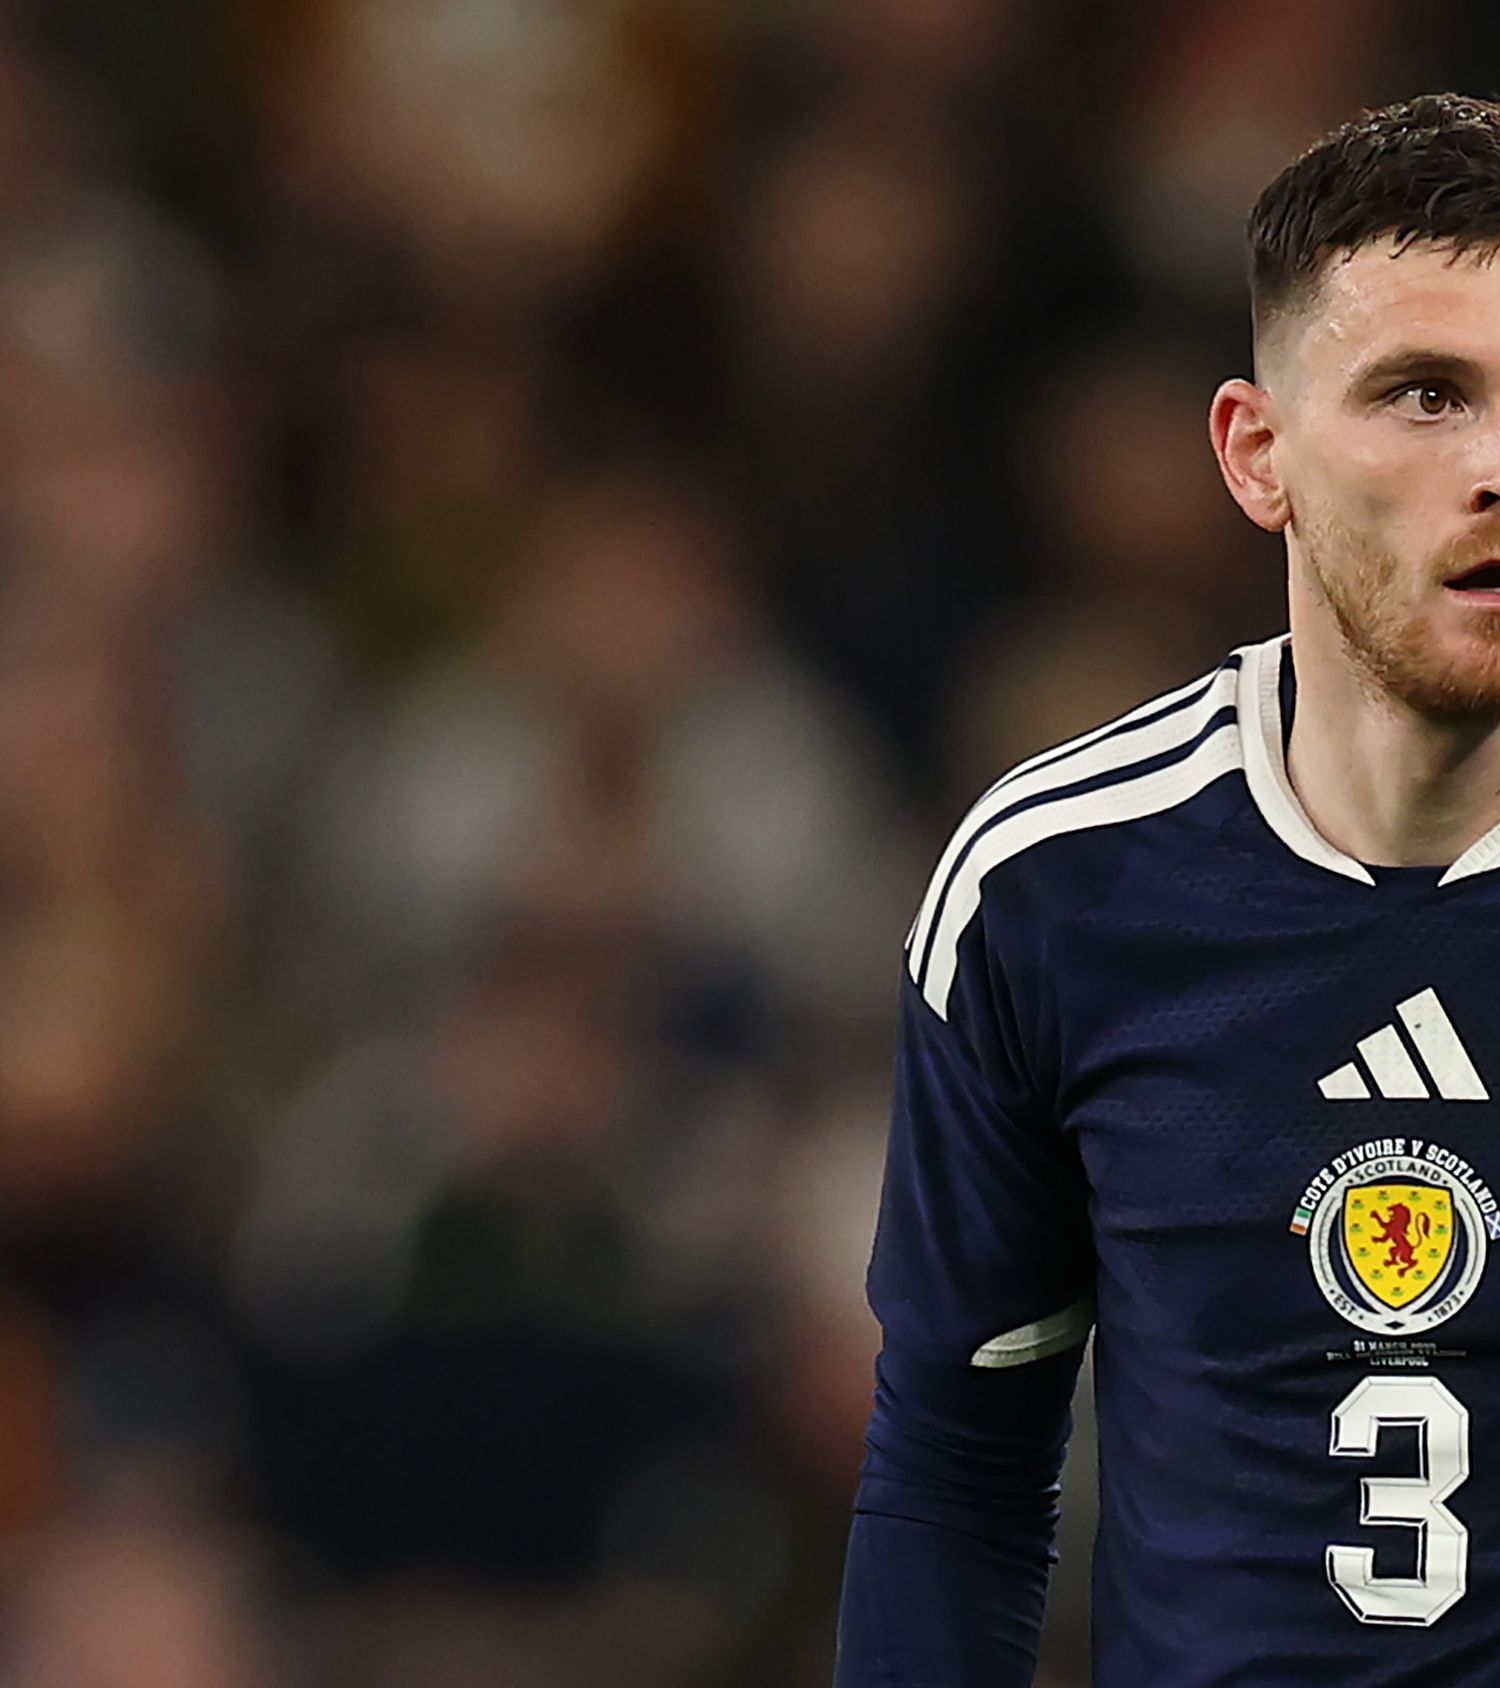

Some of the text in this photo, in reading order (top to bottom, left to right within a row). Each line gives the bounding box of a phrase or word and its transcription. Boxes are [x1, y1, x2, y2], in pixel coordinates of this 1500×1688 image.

[1299, 1138, 1498, 1214] COTE D'IVOIRE V SCOTLAND
[1354, 1159, 1441, 1182] SCOTLAND
[1334, 1294, 1357, 1316] EST
[1433, 1293, 1461, 1319] 1873
[1326, 1376, 1469, 1627] 3
